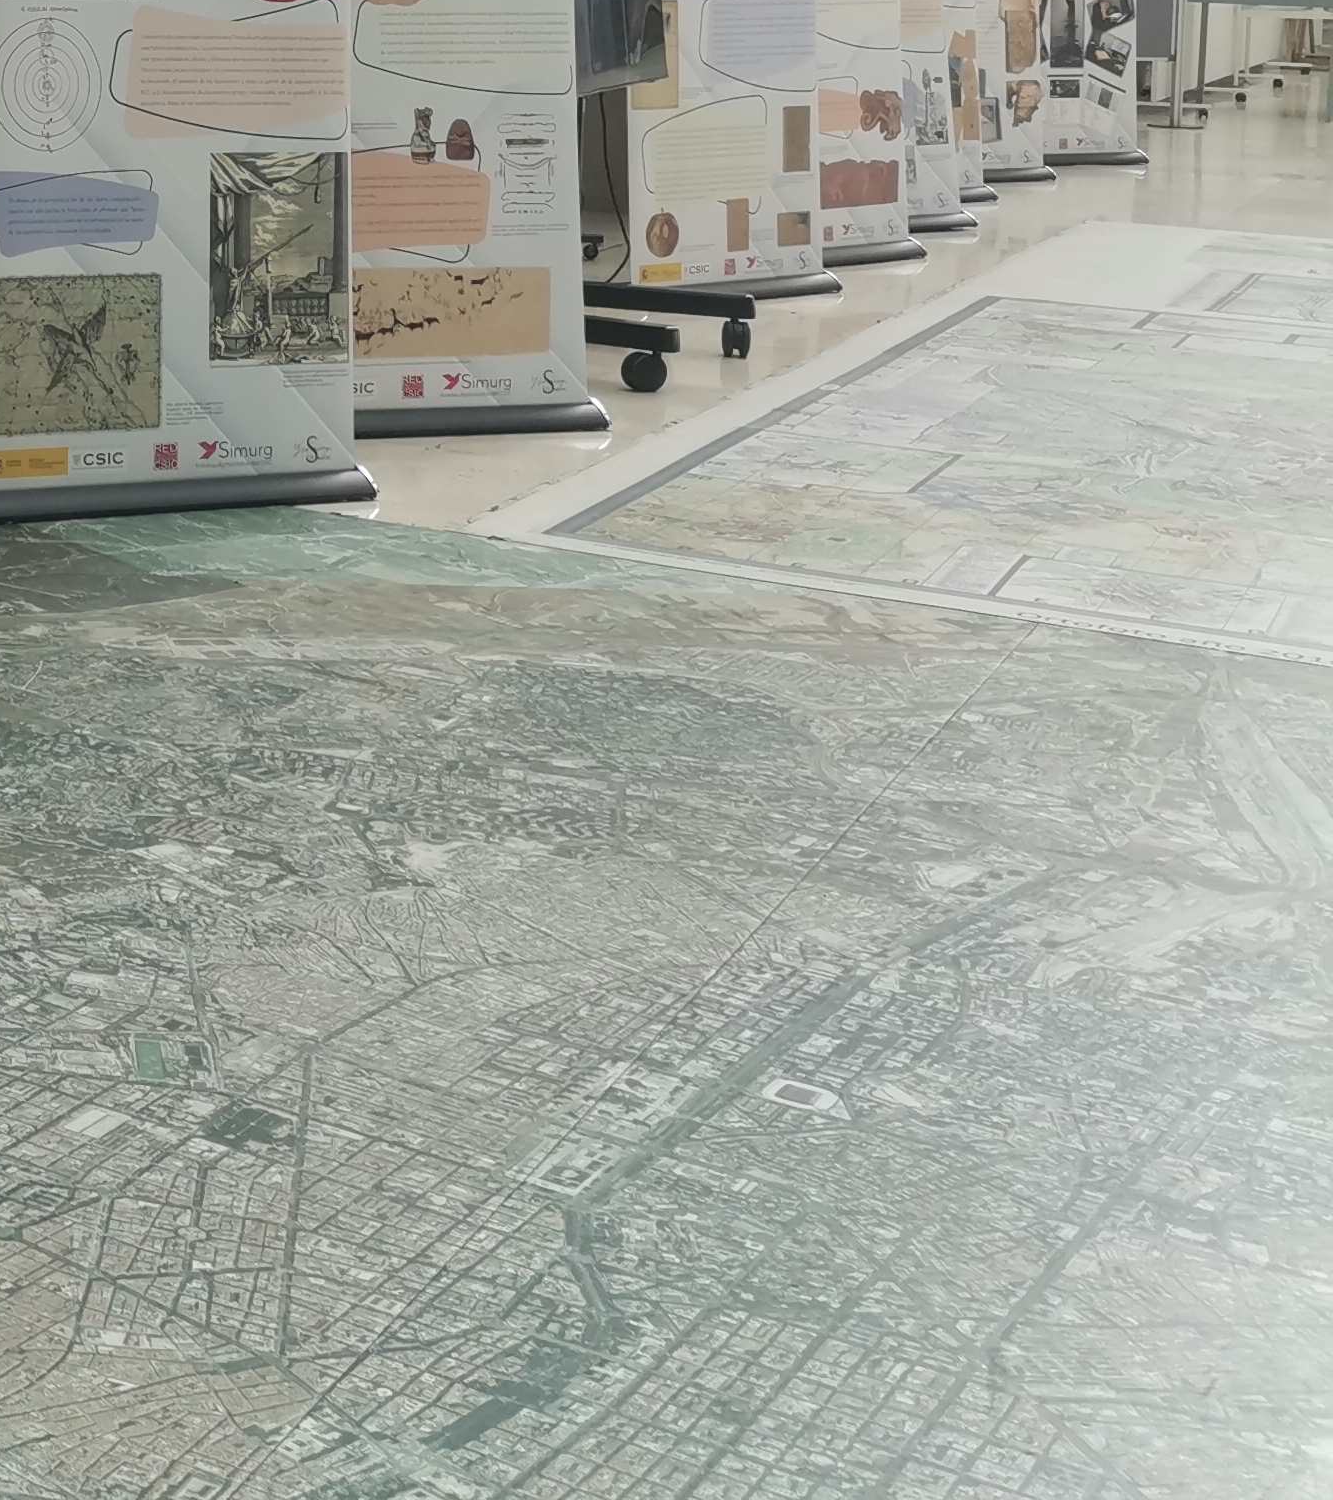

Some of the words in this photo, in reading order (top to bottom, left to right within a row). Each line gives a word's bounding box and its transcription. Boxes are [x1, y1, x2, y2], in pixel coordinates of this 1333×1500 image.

[689, 264, 709, 274] CSIC
[461, 374, 512, 390] Simurg
[154, 442, 178, 453] RED
[218, 441, 273, 459] Simurg
[83, 452, 124, 466] CSIC
